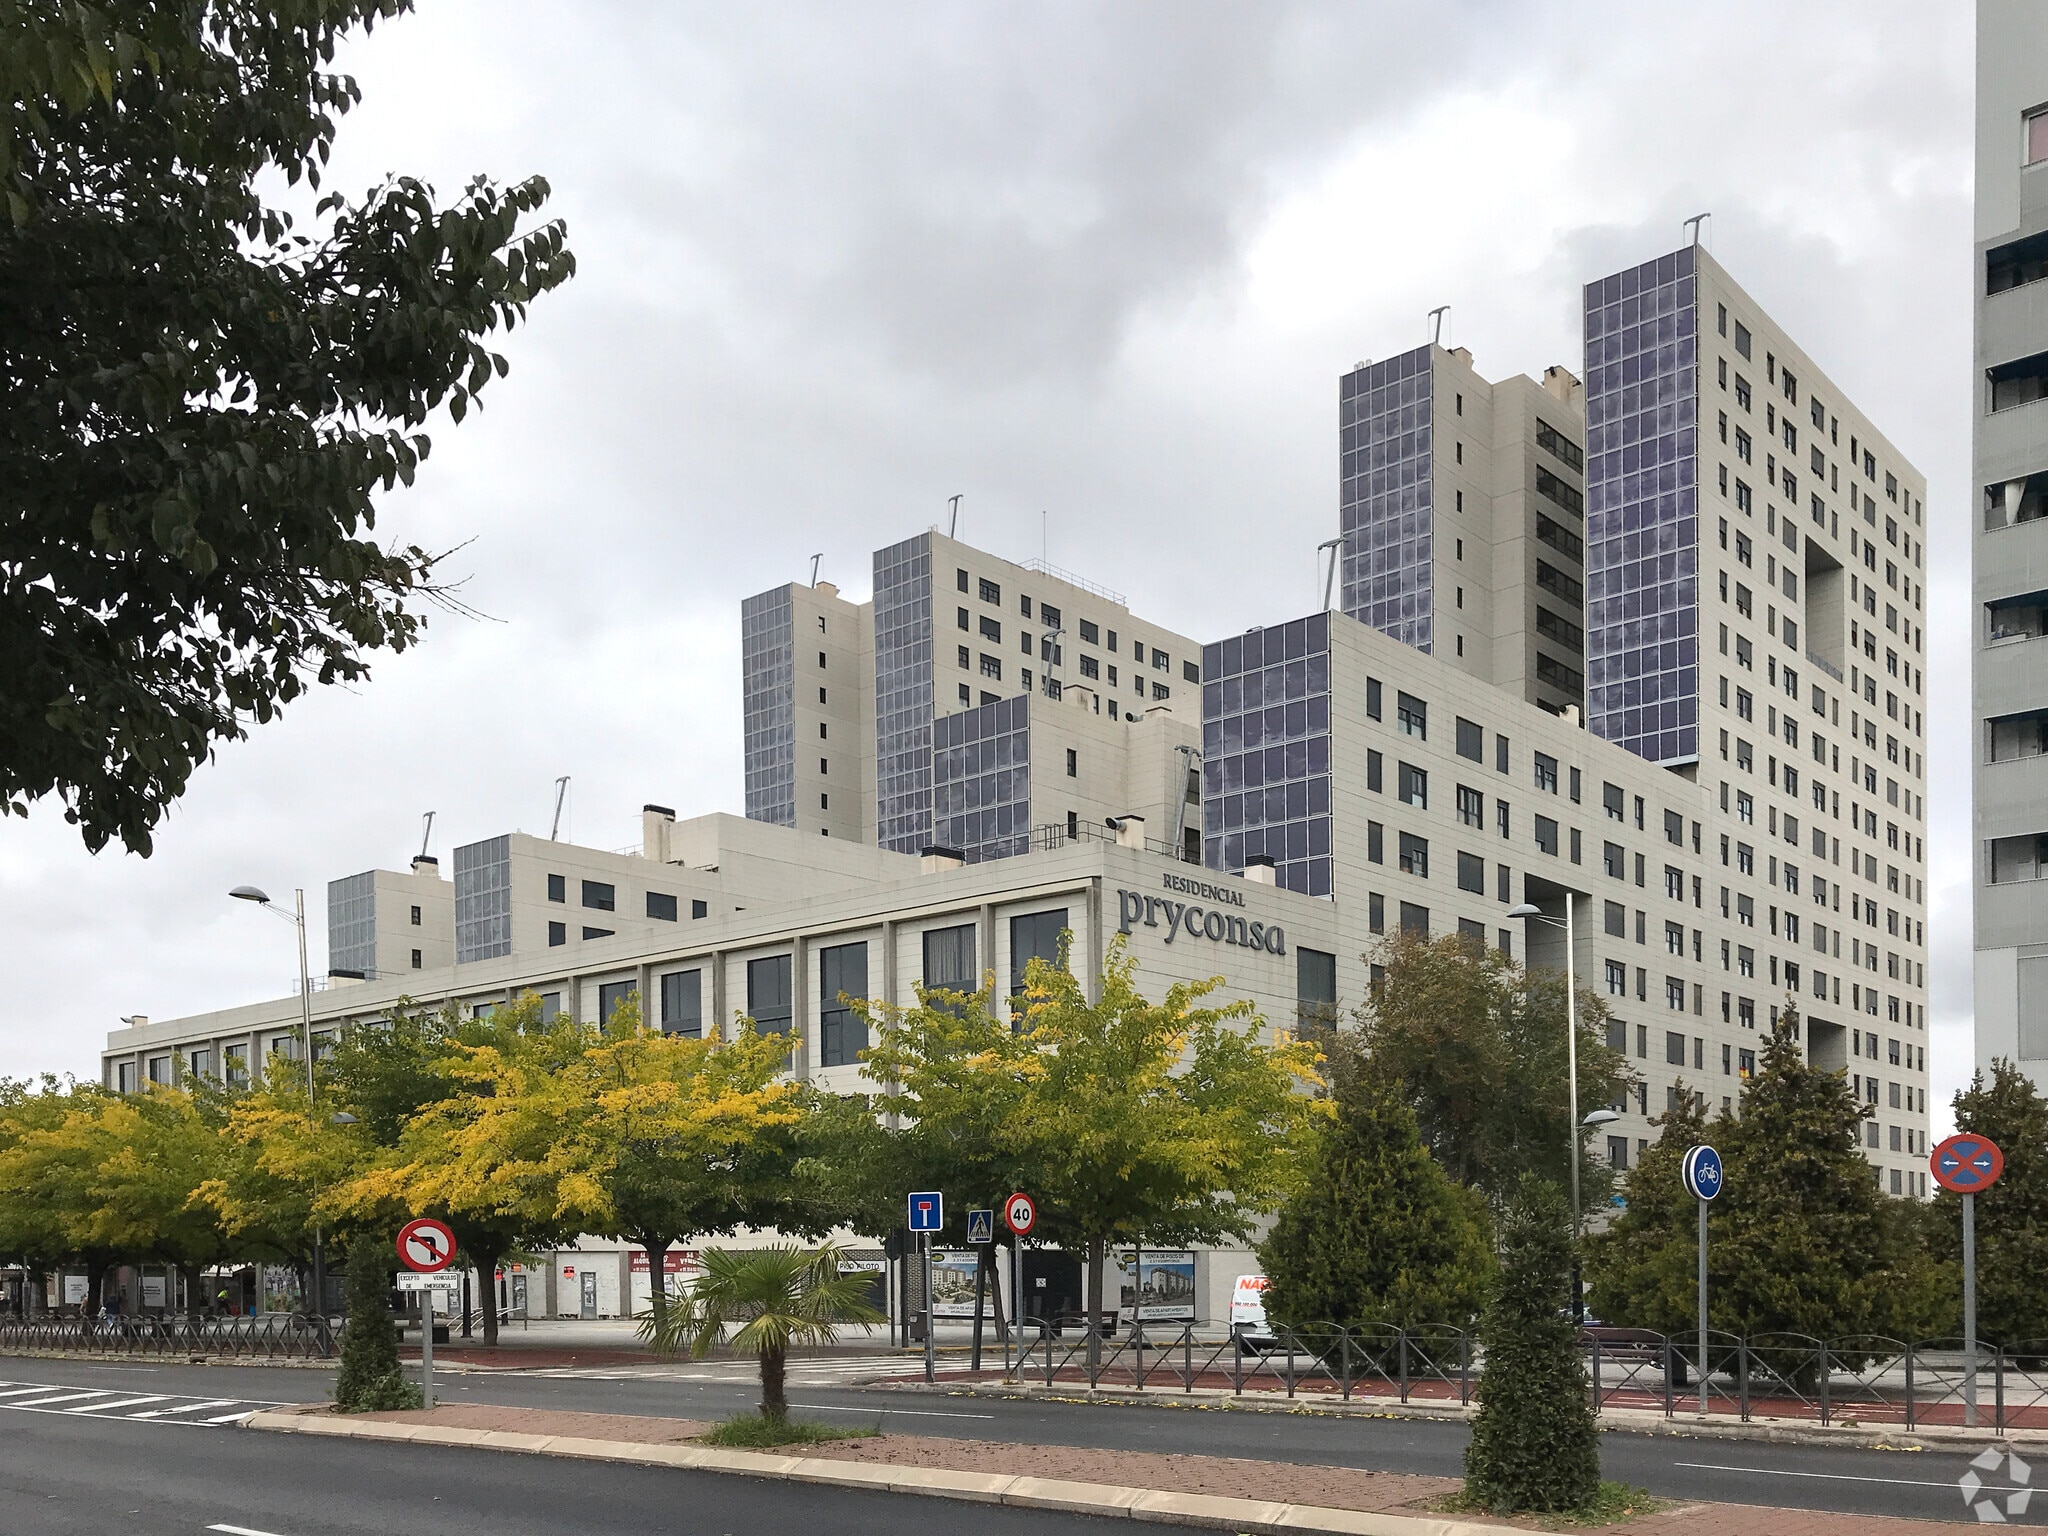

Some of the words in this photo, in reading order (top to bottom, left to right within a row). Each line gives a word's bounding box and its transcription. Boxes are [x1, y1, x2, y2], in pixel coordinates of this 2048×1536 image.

[1163, 873, 1246, 907] RESIDENCIAL
[1117, 888, 1287, 956] pryconsa
[1013, 1208, 1030, 1221] 40
